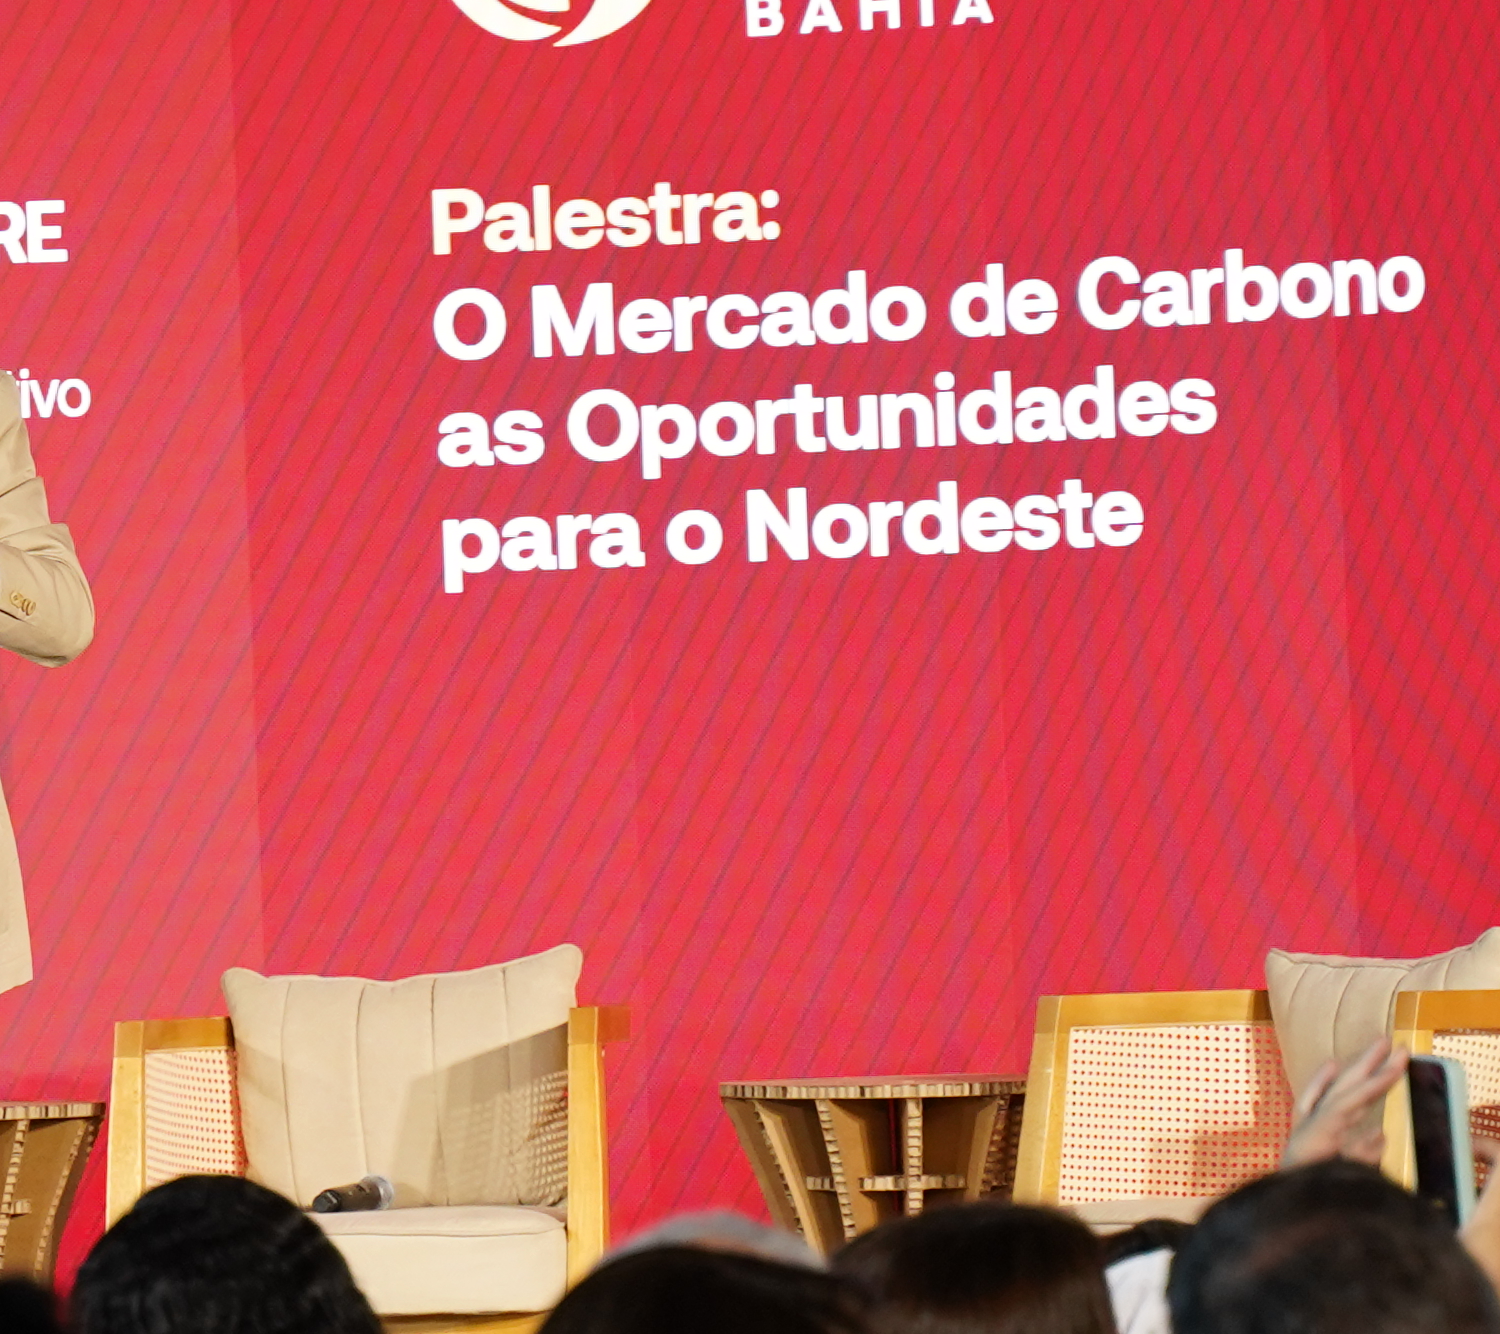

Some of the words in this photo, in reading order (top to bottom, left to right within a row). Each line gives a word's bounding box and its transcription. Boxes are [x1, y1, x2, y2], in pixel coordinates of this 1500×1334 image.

[432, 182, 780, 255] Palestra:
[433, 288, 506, 360] O
[532, 270, 926, 357] Mercado
[950, 263, 1058, 337] de
[1078, 249, 1425, 330] Carbono
[438, 410, 545, 467] as
[567, 365, 1217, 479] Oportunidades
[442, 513, 645, 593] para
[666, 510, 723, 564] o
[746, 479, 1144, 562] Nordeste
